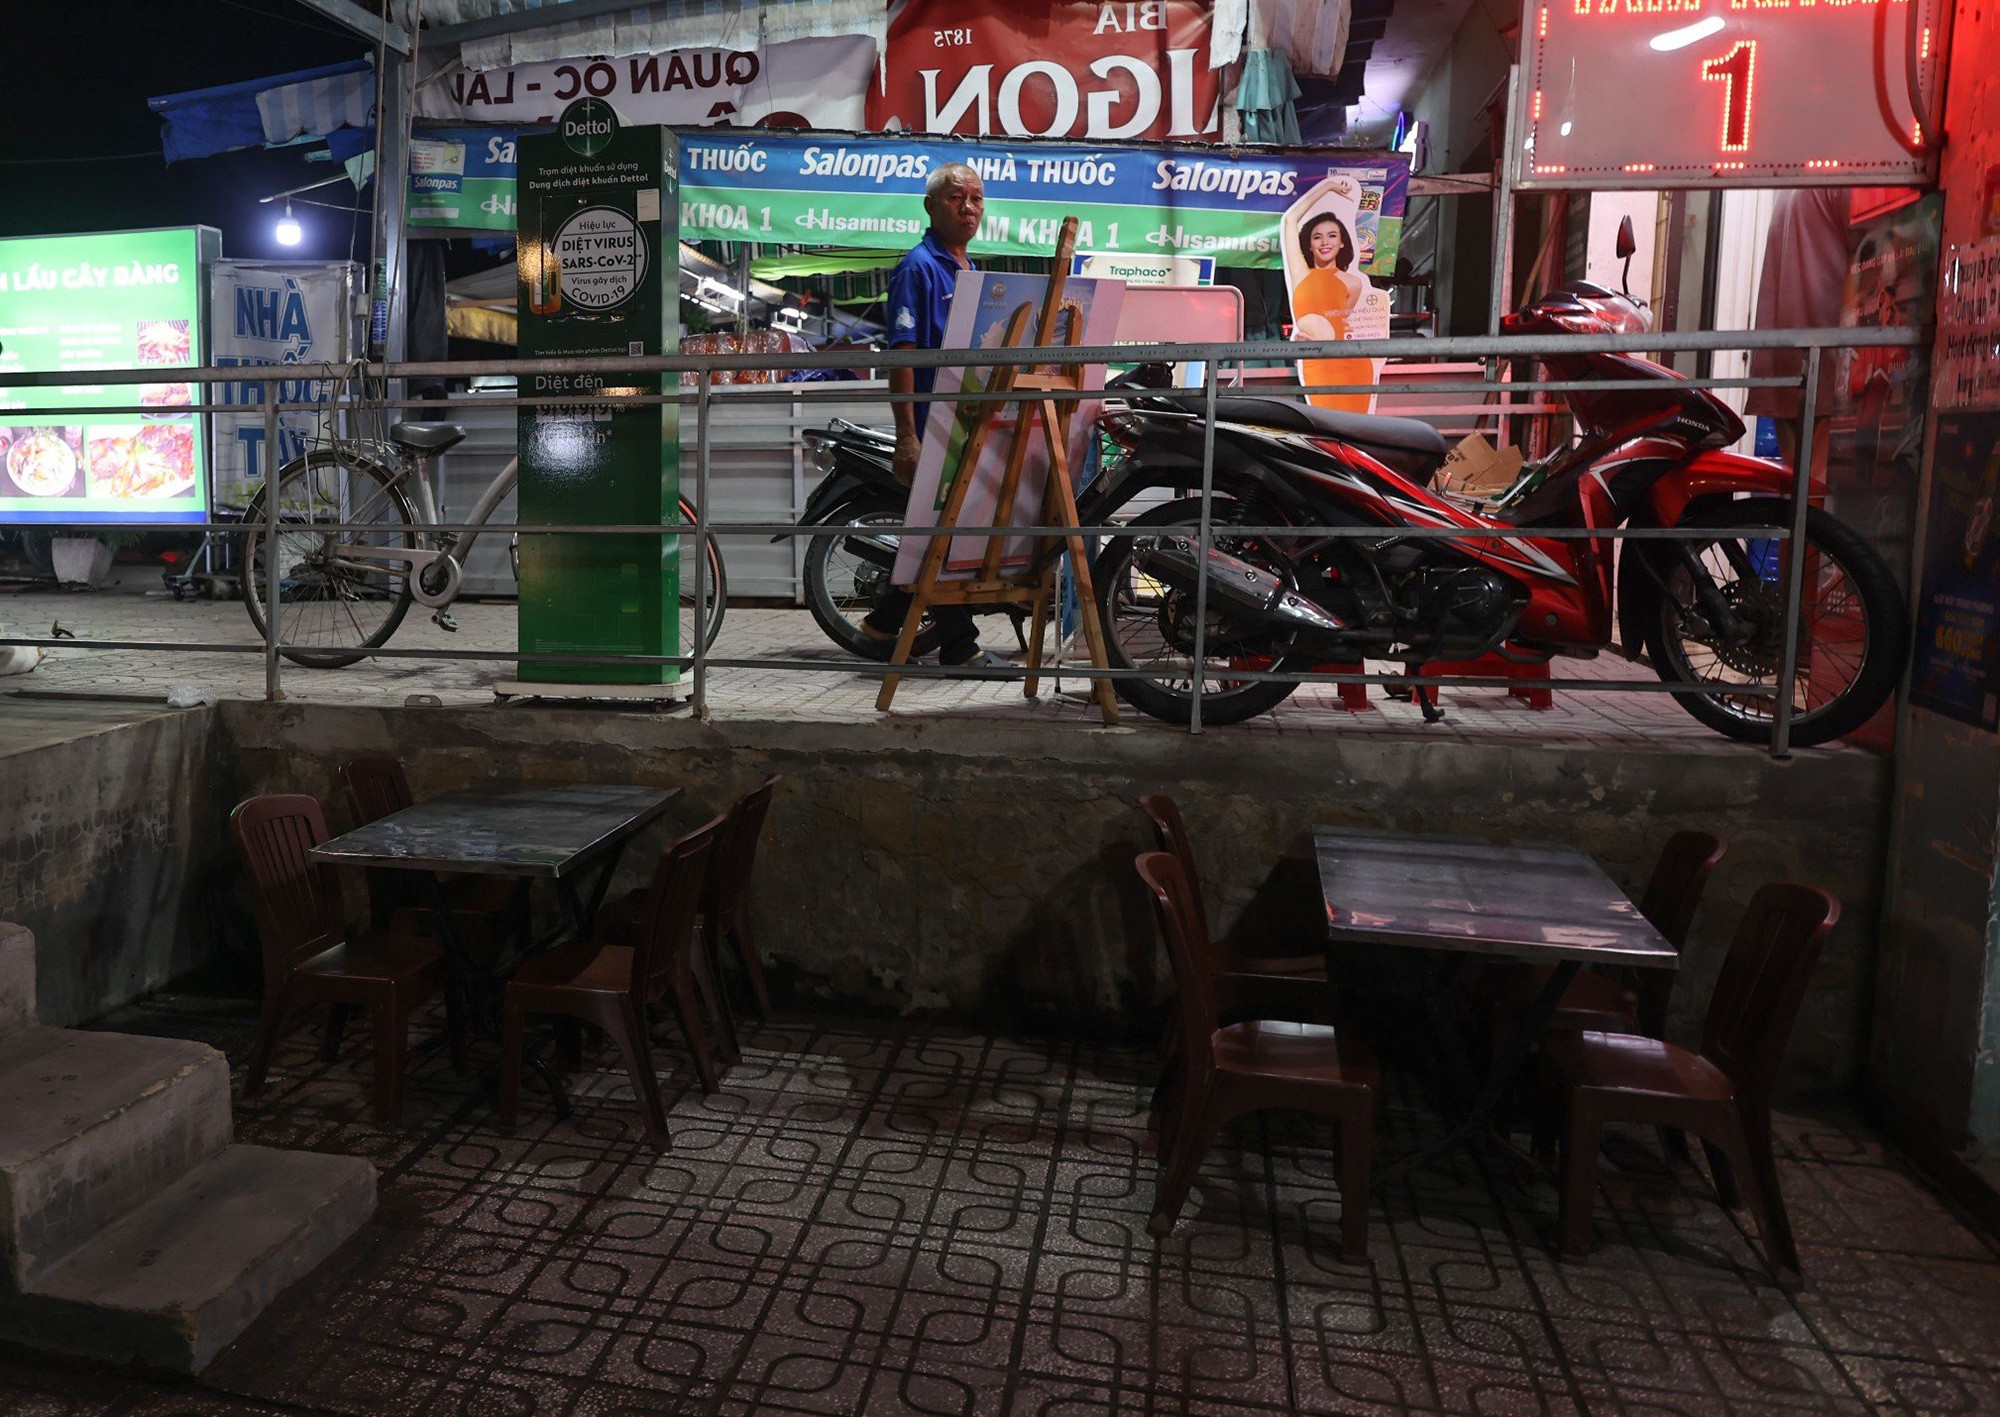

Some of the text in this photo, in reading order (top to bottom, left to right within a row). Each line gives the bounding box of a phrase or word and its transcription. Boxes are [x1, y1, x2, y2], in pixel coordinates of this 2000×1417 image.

[1702, 40, 1757, 151] 1
[565, 118, 611, 136] Dettol
[539, 167, 559, 177] Trạm
[561, 165, 577, 175] diệt
[580, 162, 605, 173] khuẩn
[617, 162, 639, 172] dụng
[688, 142, 929, 183] THUỐC Salonpas
[414, 177, 458, 190] Salonpas
[529, 173, 649, 189] Dung dịch diệt khuẩn Dettol
[1027, 154, 1116, 186] THUỐC
[1152, 160, 1298, 200] Salonpas
[580, 221, 600, 231] Hiệu
[681, 203, 749, 231] KHOA
[760, 207, 772, 231] 1
[1018, 217, 1094, 248] KHA
[1105, 223, 1119, 248] 1
[562, 236, 633, 254] DIỆT VIRUS
[572, 276, 591, 285] Virus
[609, 275, 627, 285] dịch
[1110, 265, 1166, 277] Traphaco
[571, 285, 626, 305] COVID-19
[234, 276, 312, 344] NHÀ
[535, 374, 604, 393] Diệt đến
[1676, 416, 1710, 432] HONDA
